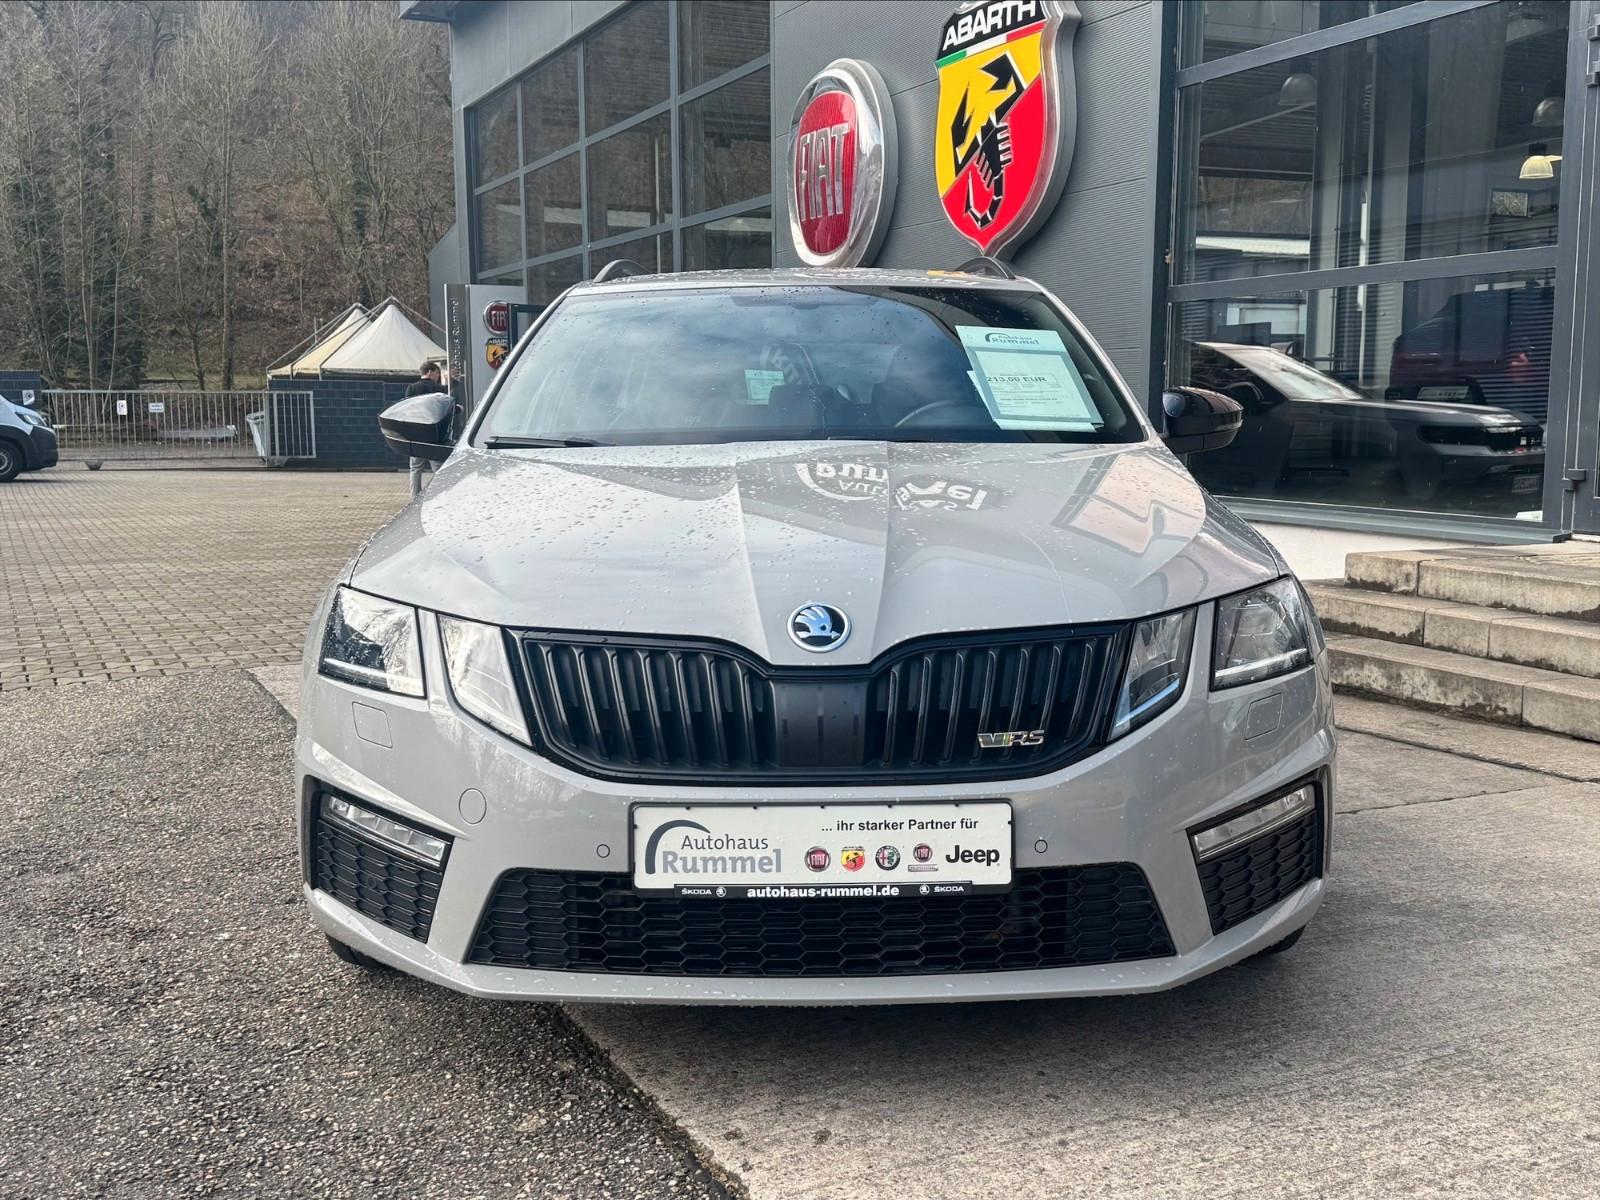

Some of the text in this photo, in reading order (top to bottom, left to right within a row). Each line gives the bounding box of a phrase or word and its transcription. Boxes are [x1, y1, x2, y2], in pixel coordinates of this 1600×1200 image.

[942, 0, 1037, 51] ABARTH
[799, 122, 850, 222] FIAT
[836, 819, 854, 831] ihr
[858, 819, 904, 831] starker
[908, 818, 956, 830] Partner
[960, 817, 979, 829] für
[681, 833, 769, 850] Autohaus
[662, 848, 782, 874] Rummel
[945, 844, 1001, 867] Jeep
[681, 888, 712, 896] ŠKODA
[746, 884, 900, 899] autohaus-rummel.de
[933, 885, 965, 893] ŠKODA
